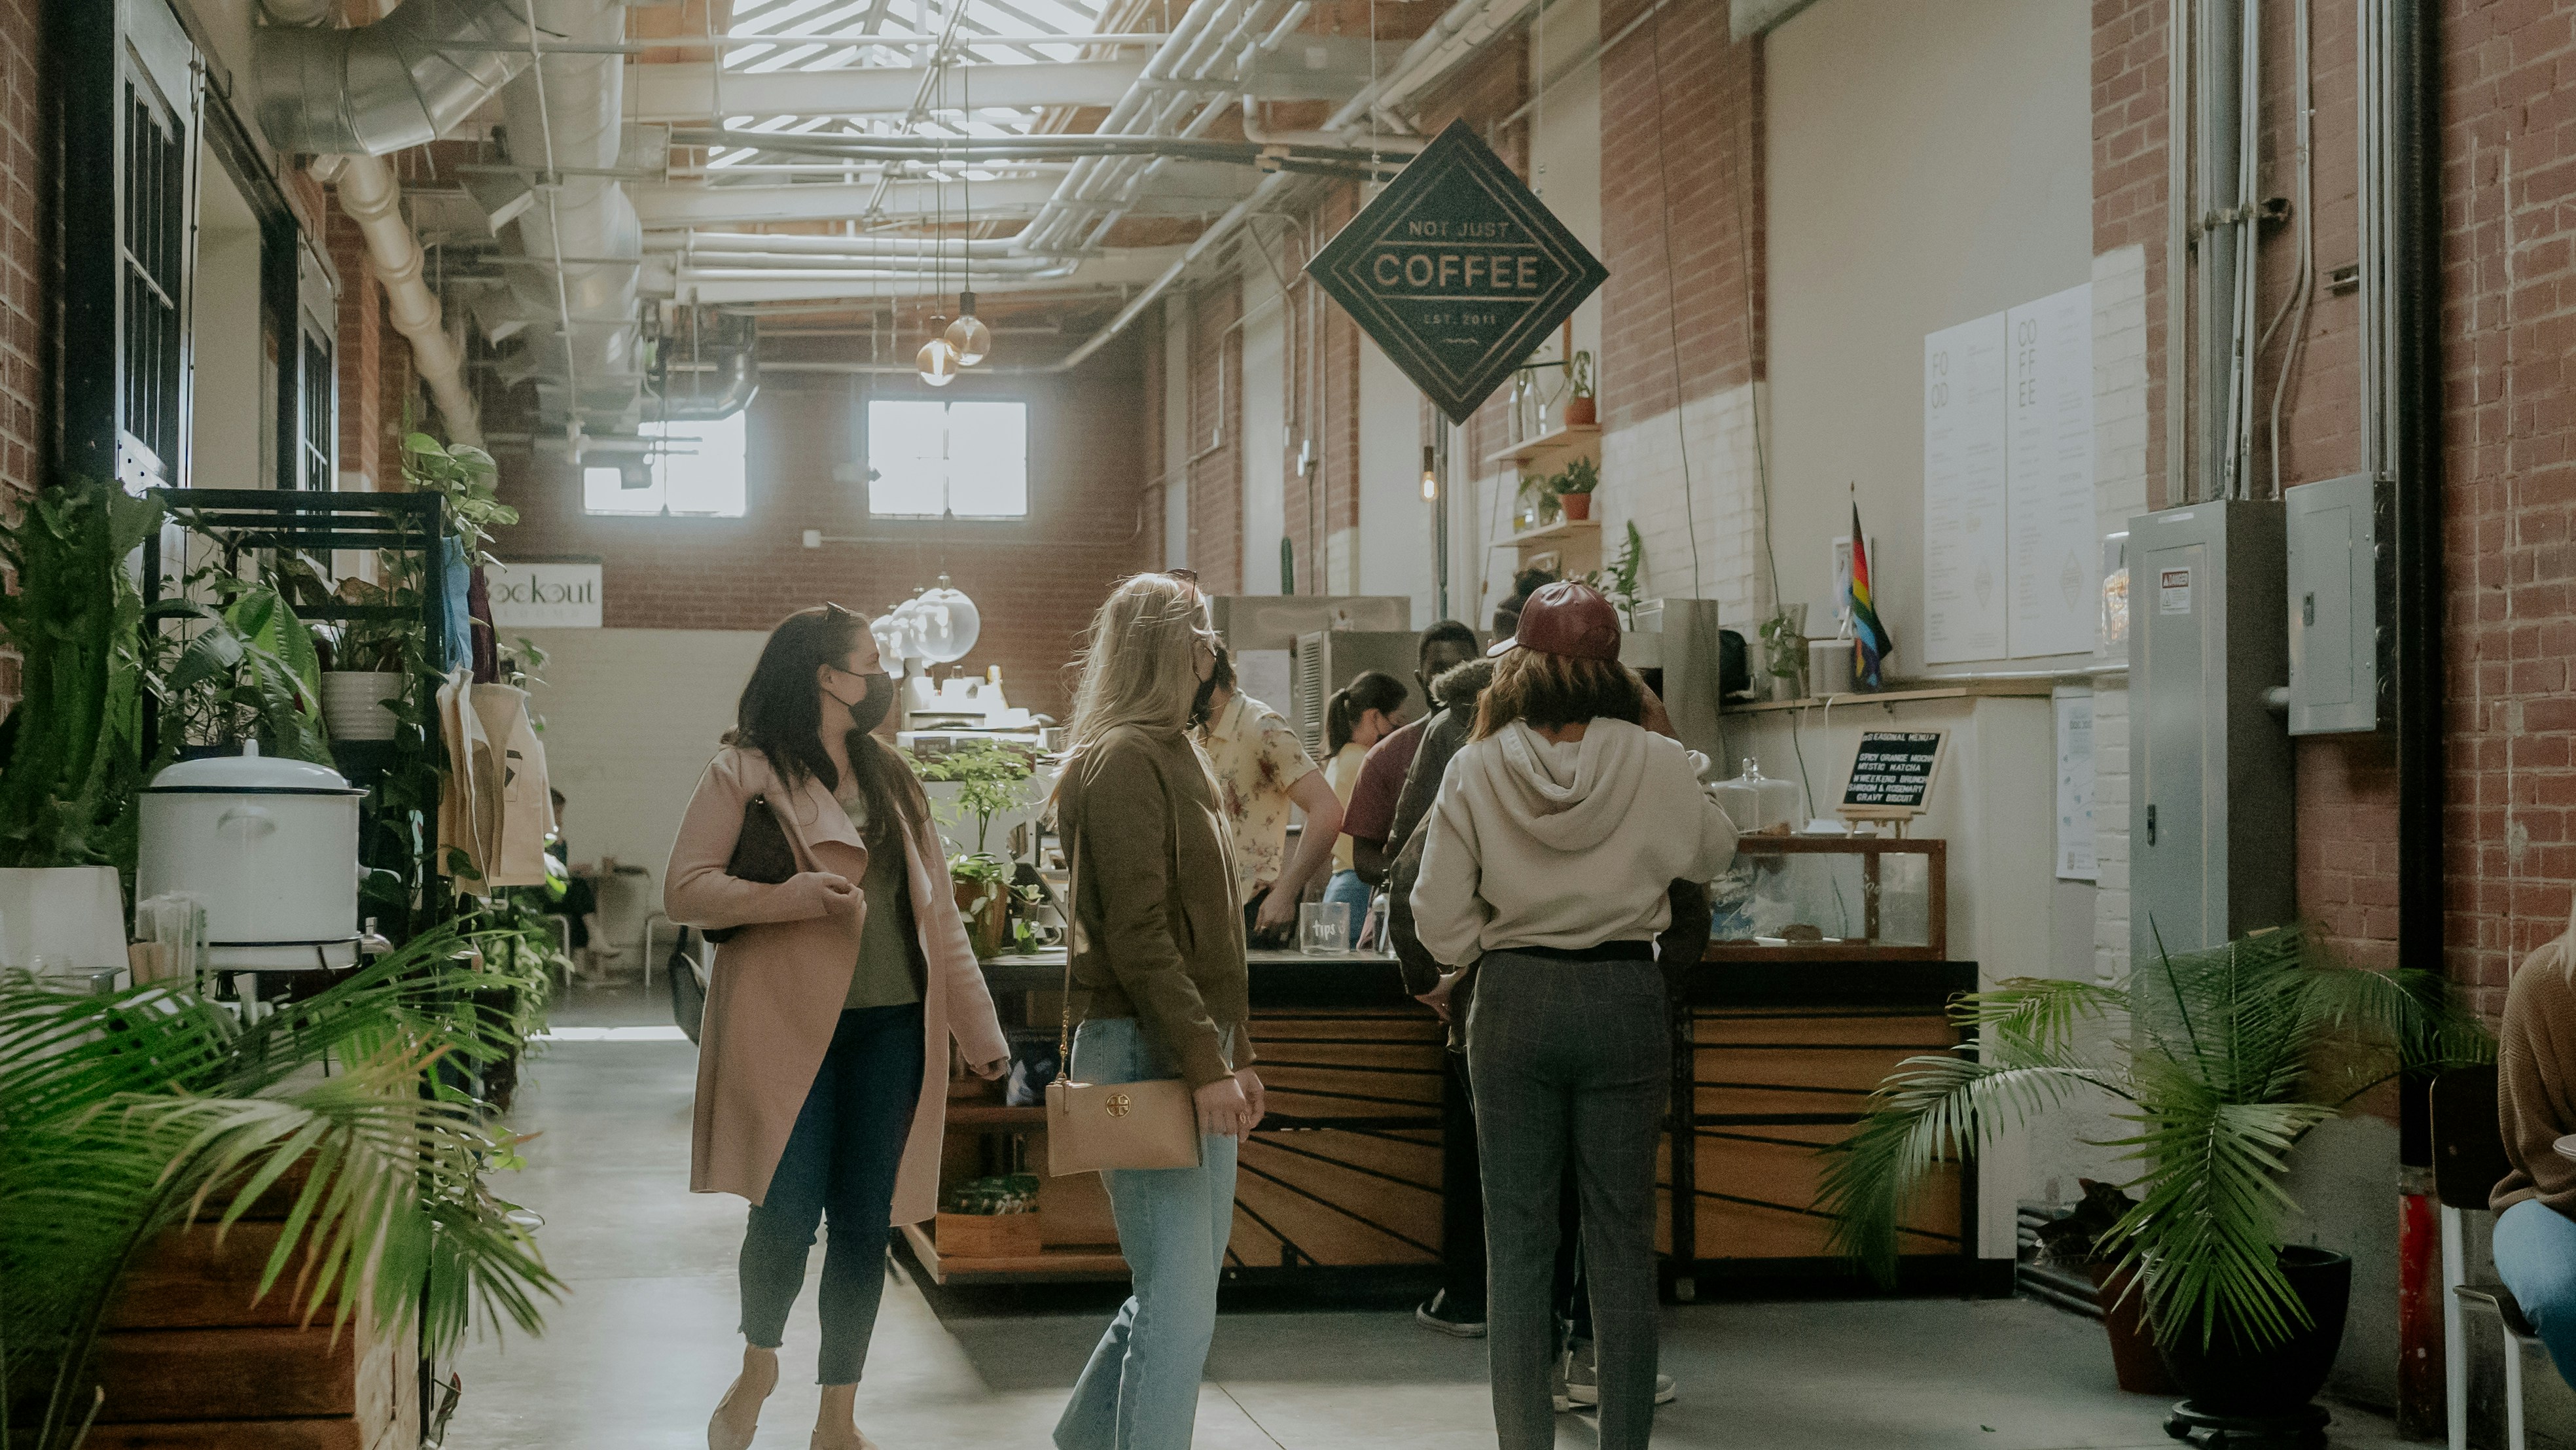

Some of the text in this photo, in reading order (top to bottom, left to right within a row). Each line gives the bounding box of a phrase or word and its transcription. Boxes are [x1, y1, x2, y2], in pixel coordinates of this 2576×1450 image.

[1408, 221, 1509, 238] NOT JUST
[1373, 253, 1539, 289] COFFEE
[1423, 315, 1458, 325] EST.
[485, 573, 596, 603] ockout
[1889, 764, 1921, 772] MATCHA
[1856, 793, 1914, 803] GRAVY BISCUIT
[1312, 919, 1336, 941] tips
